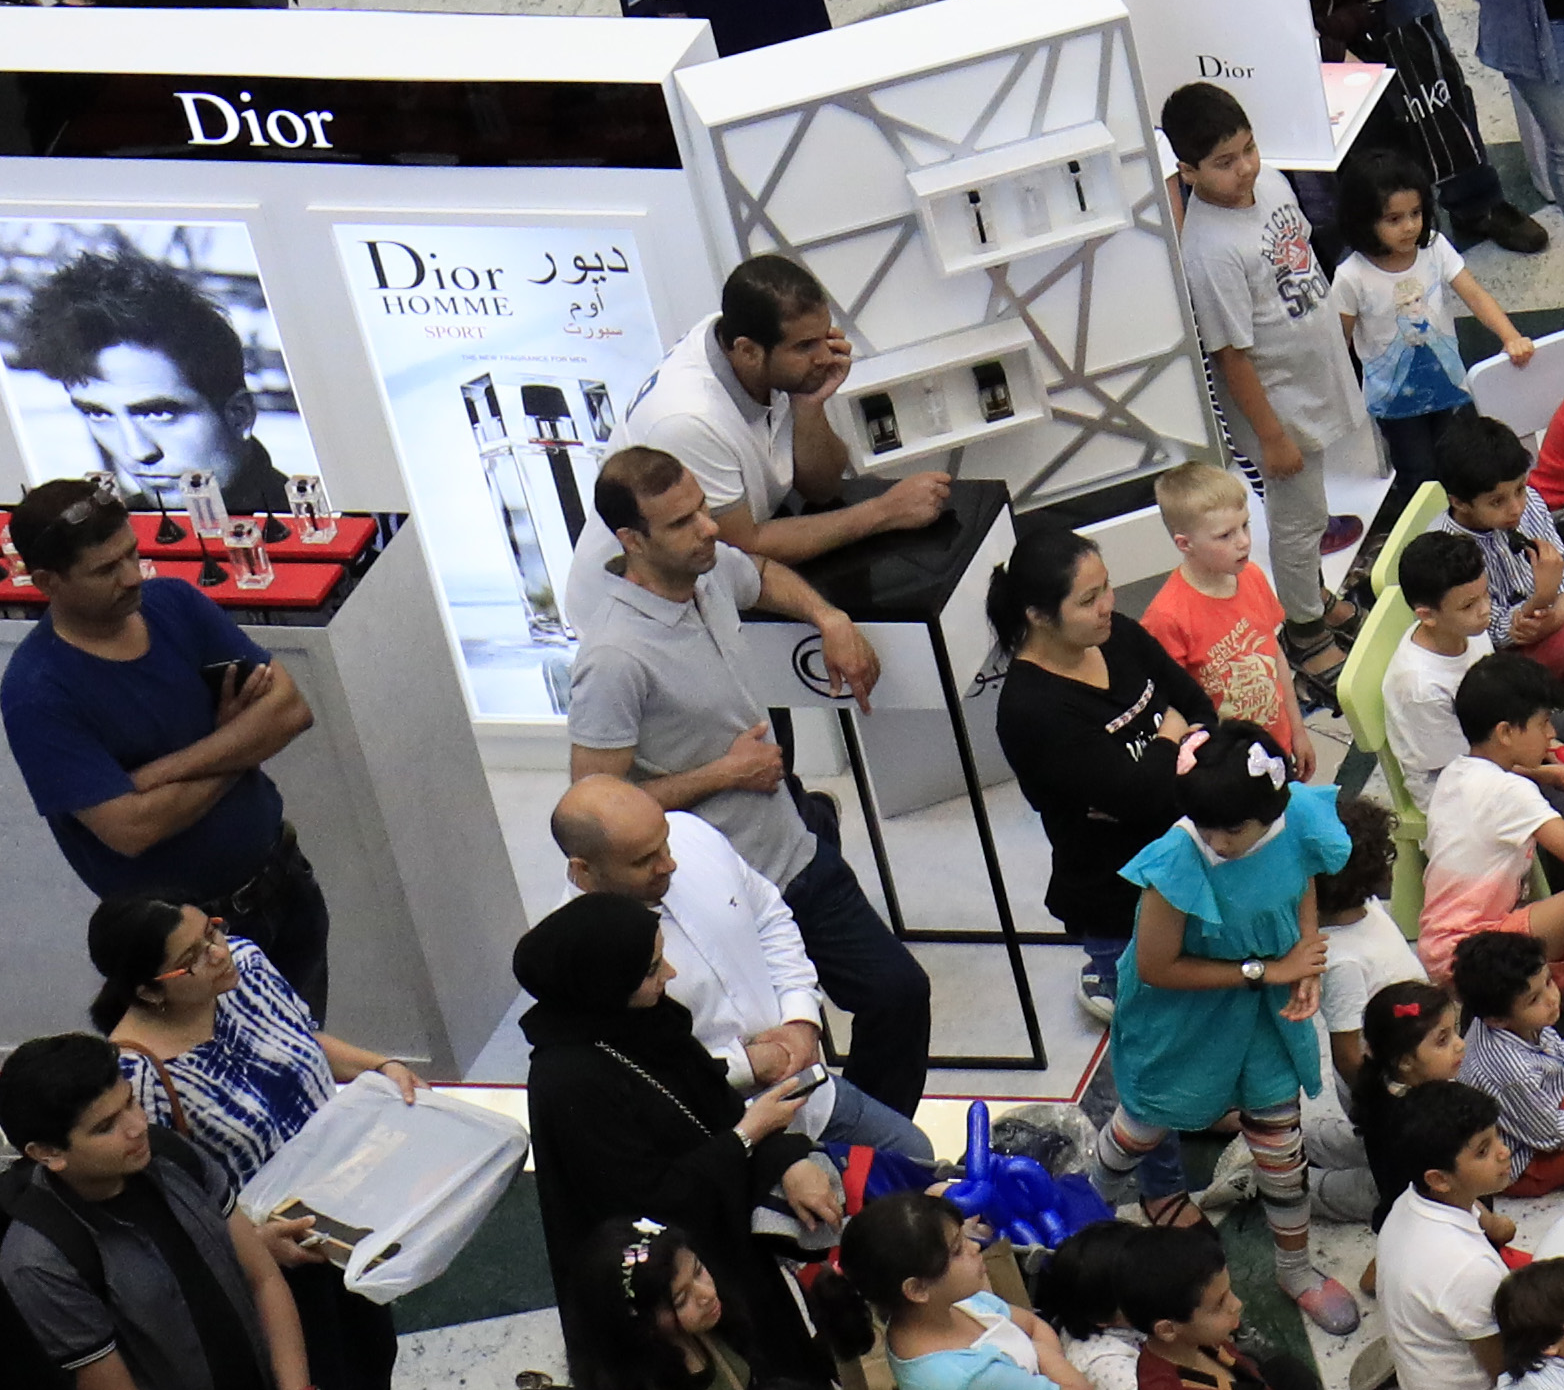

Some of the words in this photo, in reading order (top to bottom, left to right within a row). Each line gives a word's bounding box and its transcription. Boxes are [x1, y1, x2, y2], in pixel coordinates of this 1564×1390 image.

[1195, 54, 1255, 78] Dior
[172, 91, 334, 149] Dior
[357, 240, 504, 291] Dior
[527, 246, 630, 285] ديور
[381, 294, 514, 317] HOMME
[569, 286, 604, 321] أوم
[424, 325, 486, 340] SPORT
[1206, 616, 1250, 659] VINTAGE
